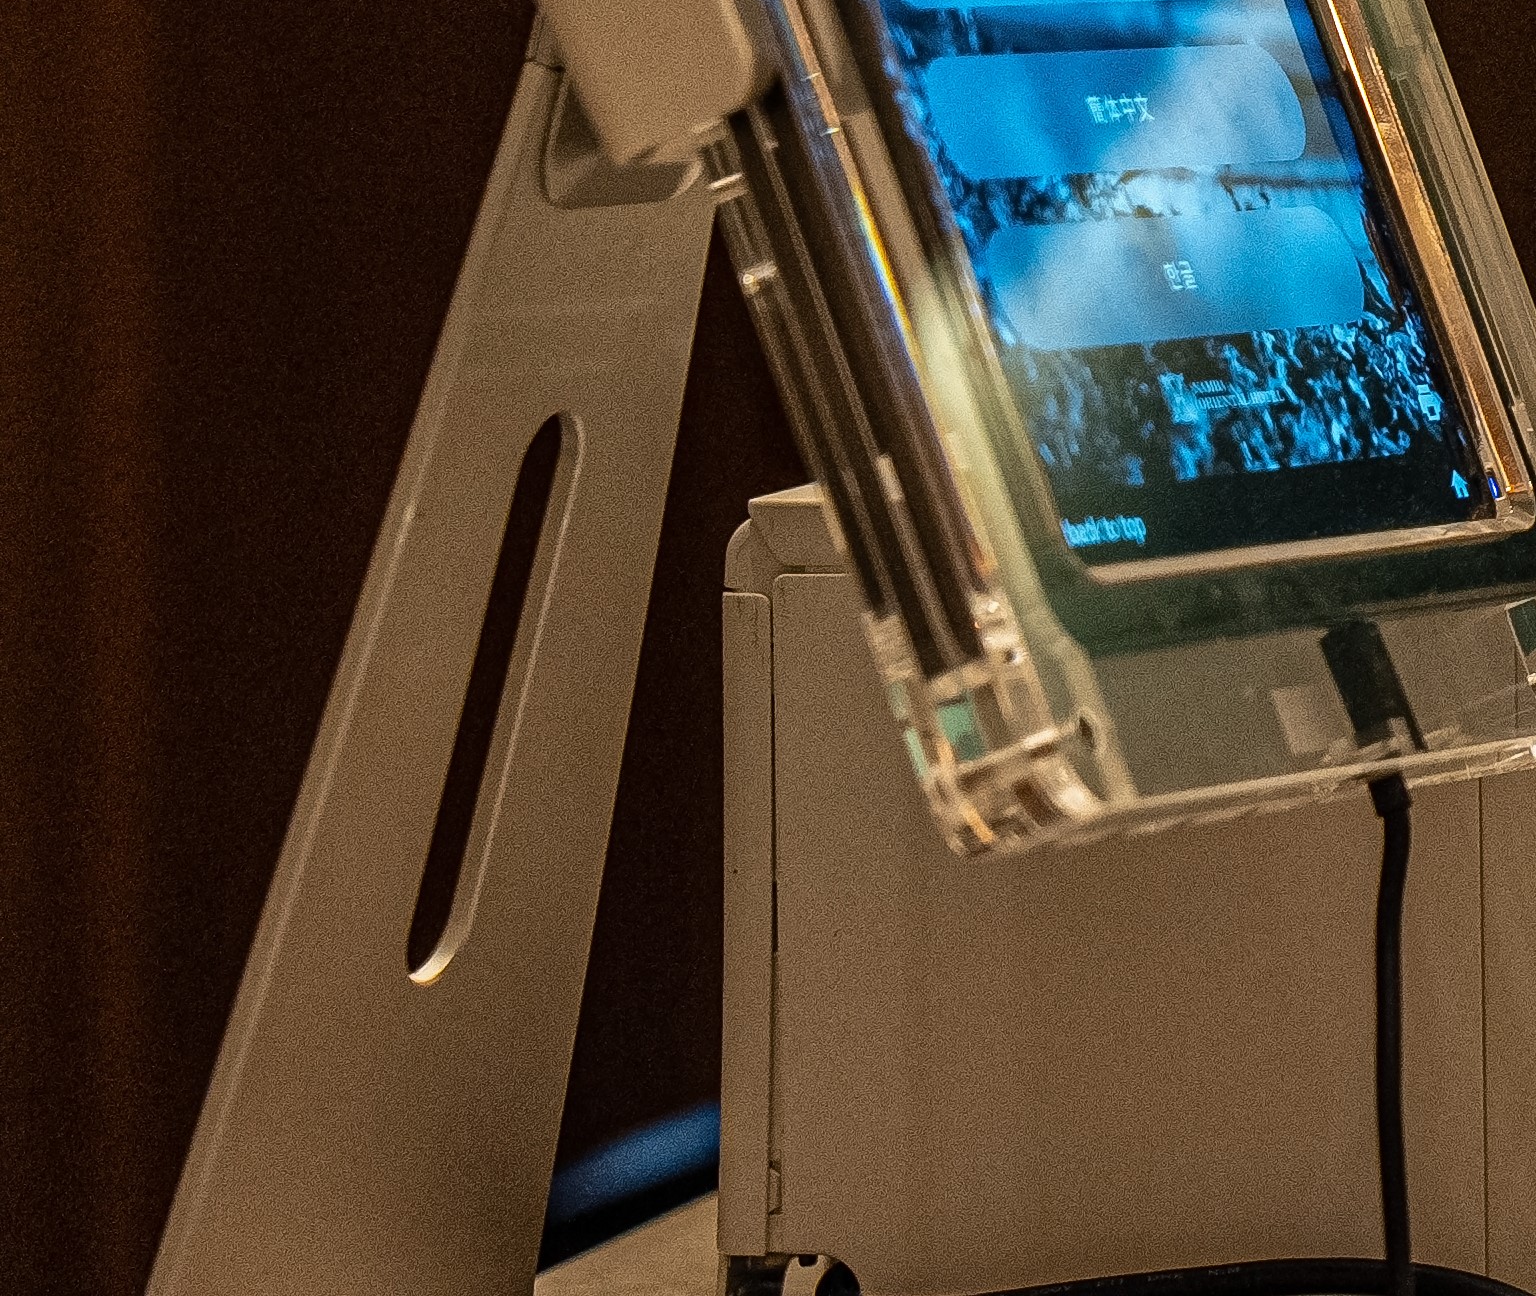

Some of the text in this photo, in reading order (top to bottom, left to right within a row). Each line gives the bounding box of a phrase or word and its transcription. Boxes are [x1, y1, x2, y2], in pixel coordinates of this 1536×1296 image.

[1162, 260, 1198, 292] 한글
[1061, 514, 1147, 549] back to top
